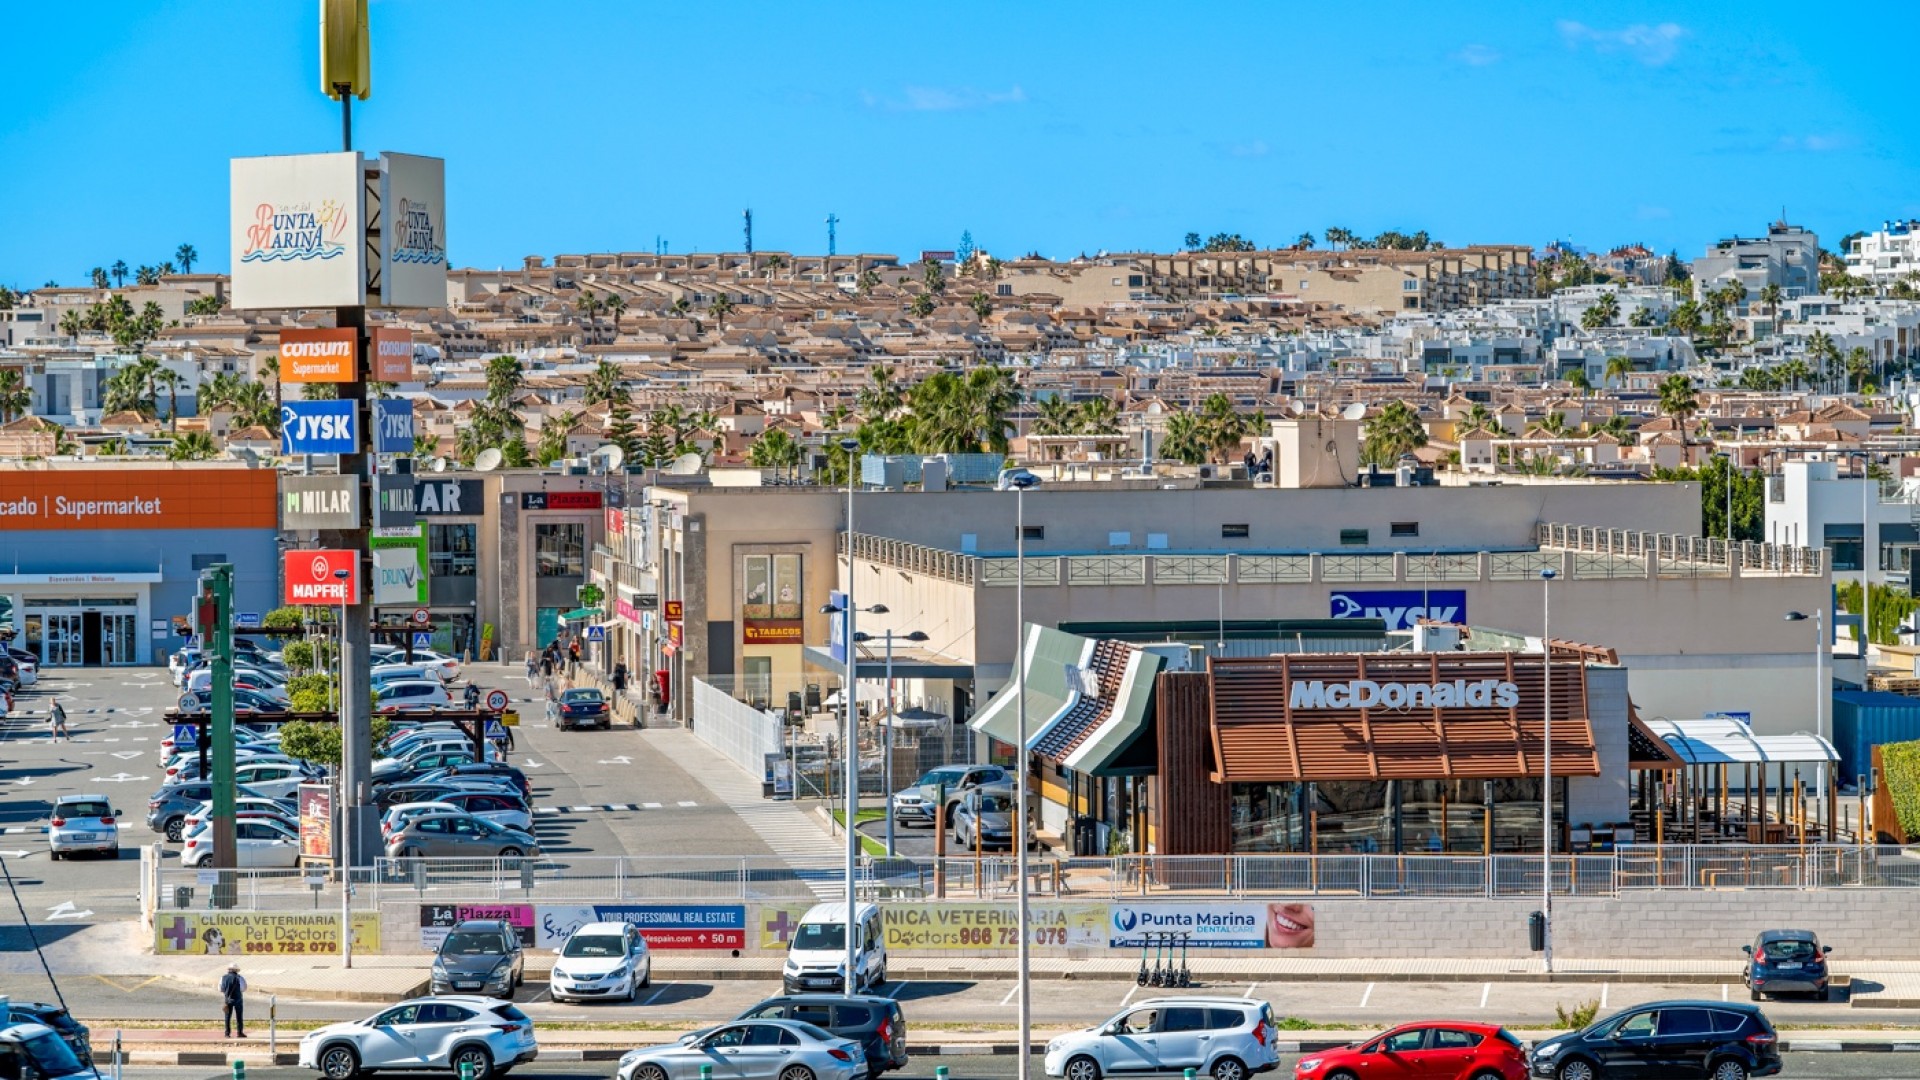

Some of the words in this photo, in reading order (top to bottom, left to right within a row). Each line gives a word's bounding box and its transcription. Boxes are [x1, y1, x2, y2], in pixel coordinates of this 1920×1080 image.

[255, 203, 316, 231] PUNTA
[399, 198, 430, 231] PUNTA
[243, 223, 323, 255] MARINA
[394, 220, 433, 256] MARINA
[282, 340, 350, 357] consum
[378, 340, 411, 357] consum
[292, 361, 340, 377] Supermarket
[383, 361, 407, 376] Supermarket
[296, 414, 352, 441] JYSK
[386, 414, 412, 439] JYSK
[303, 490, 351, 514] MILAR
[389, 488, 414, 512] MILAR
[528, 494, 544, 504] La
[550, 494, 591, 504] Plazza
[55, 495, 161, 520] Supermarket
[292, 584, 348, 598] MAPFRE
[491, 697, 503, 705] 20
[1290, 680, 1519, 709] McDonald's
[183, 699, 195, 707] 20
[201, 914, 250, 926] CLÍNICA
[254, 916, 336, 926] VETERINARIA
[433, 907, 453, 920] La
[459, 907, 512, 919] Plazza
[601, 912, 622, 923] YOUR
[624, 912, 683, 924] PROFESSIONAL
[684, 912, 704, 924] REAL
[705, 912, 736, 924] ESTATE
[1142, 912, 1193, 926] Punta
[1197, 911, 1255, 926] Marina
[246, 926, 268, 941] Pet
[711, 934, 725, 944] 50
[727, 936, 737, 944] m
[960, 927, 992, 945] 966
[1036, 927, 1067, 945] 079
[247, 941, 274, 953] 966
[278, 941, 305, 953] 722
[310, 941, 337, 953] 079
